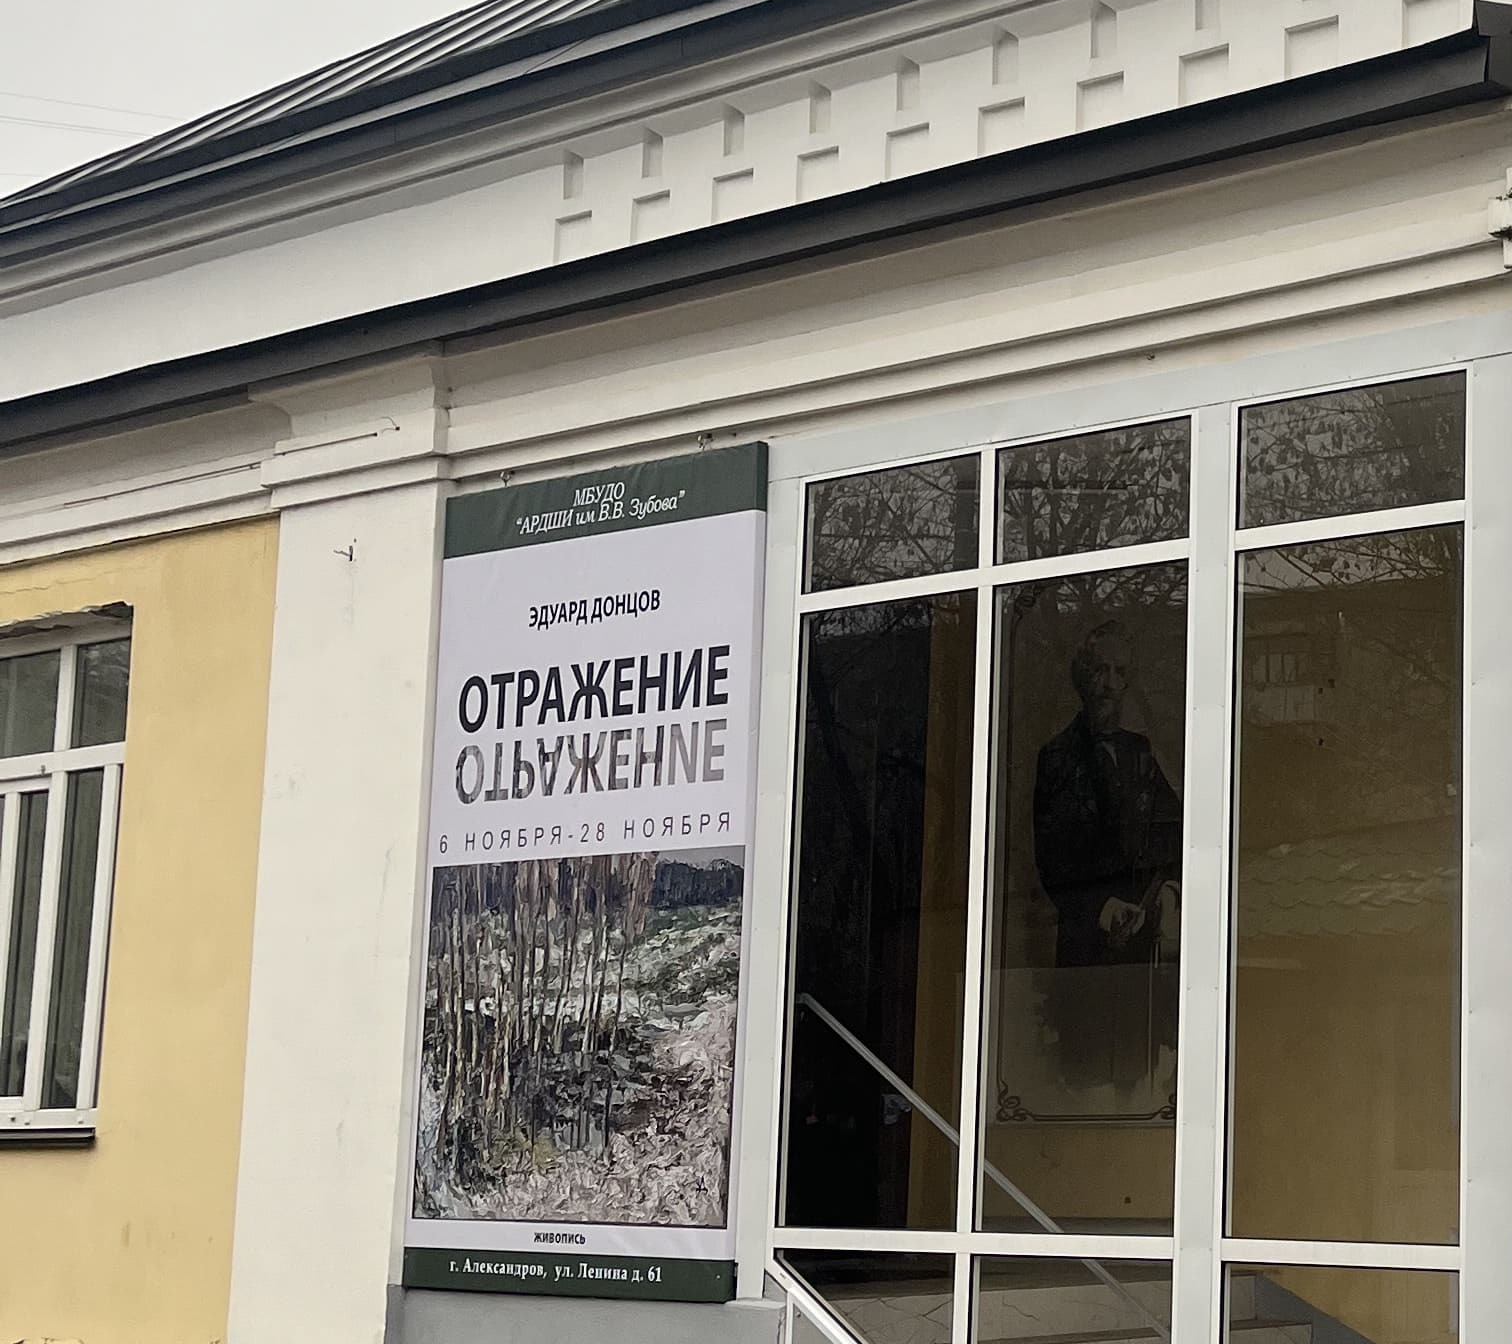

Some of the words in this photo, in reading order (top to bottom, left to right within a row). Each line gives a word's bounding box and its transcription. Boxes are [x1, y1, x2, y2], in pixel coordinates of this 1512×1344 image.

[573, 482, 625, 506] МБУДО
[575, 509, 596, 526] им
[598, 501, 625, 522] В.В.
[529, 599, 588, 631] ЭДУАРД
[591, 589, 661, 624] ДОНЦОВ
[458, 644, 731, 734] ОТРАЖЕНИЕ
[439, 835, 448, 854] 6
[624, 811, 731, 840] НОЯБРЯ
[449, 1260, 459, 1272] г.
[463, 1258, 547, 1280] Александров,
[554, 1266, 574, 1282] ул.
[577, 1263, 628, 1280] Ленина
[631, 1269, 644, 1282] д.
[647, 1266, 662, 1282] 61
